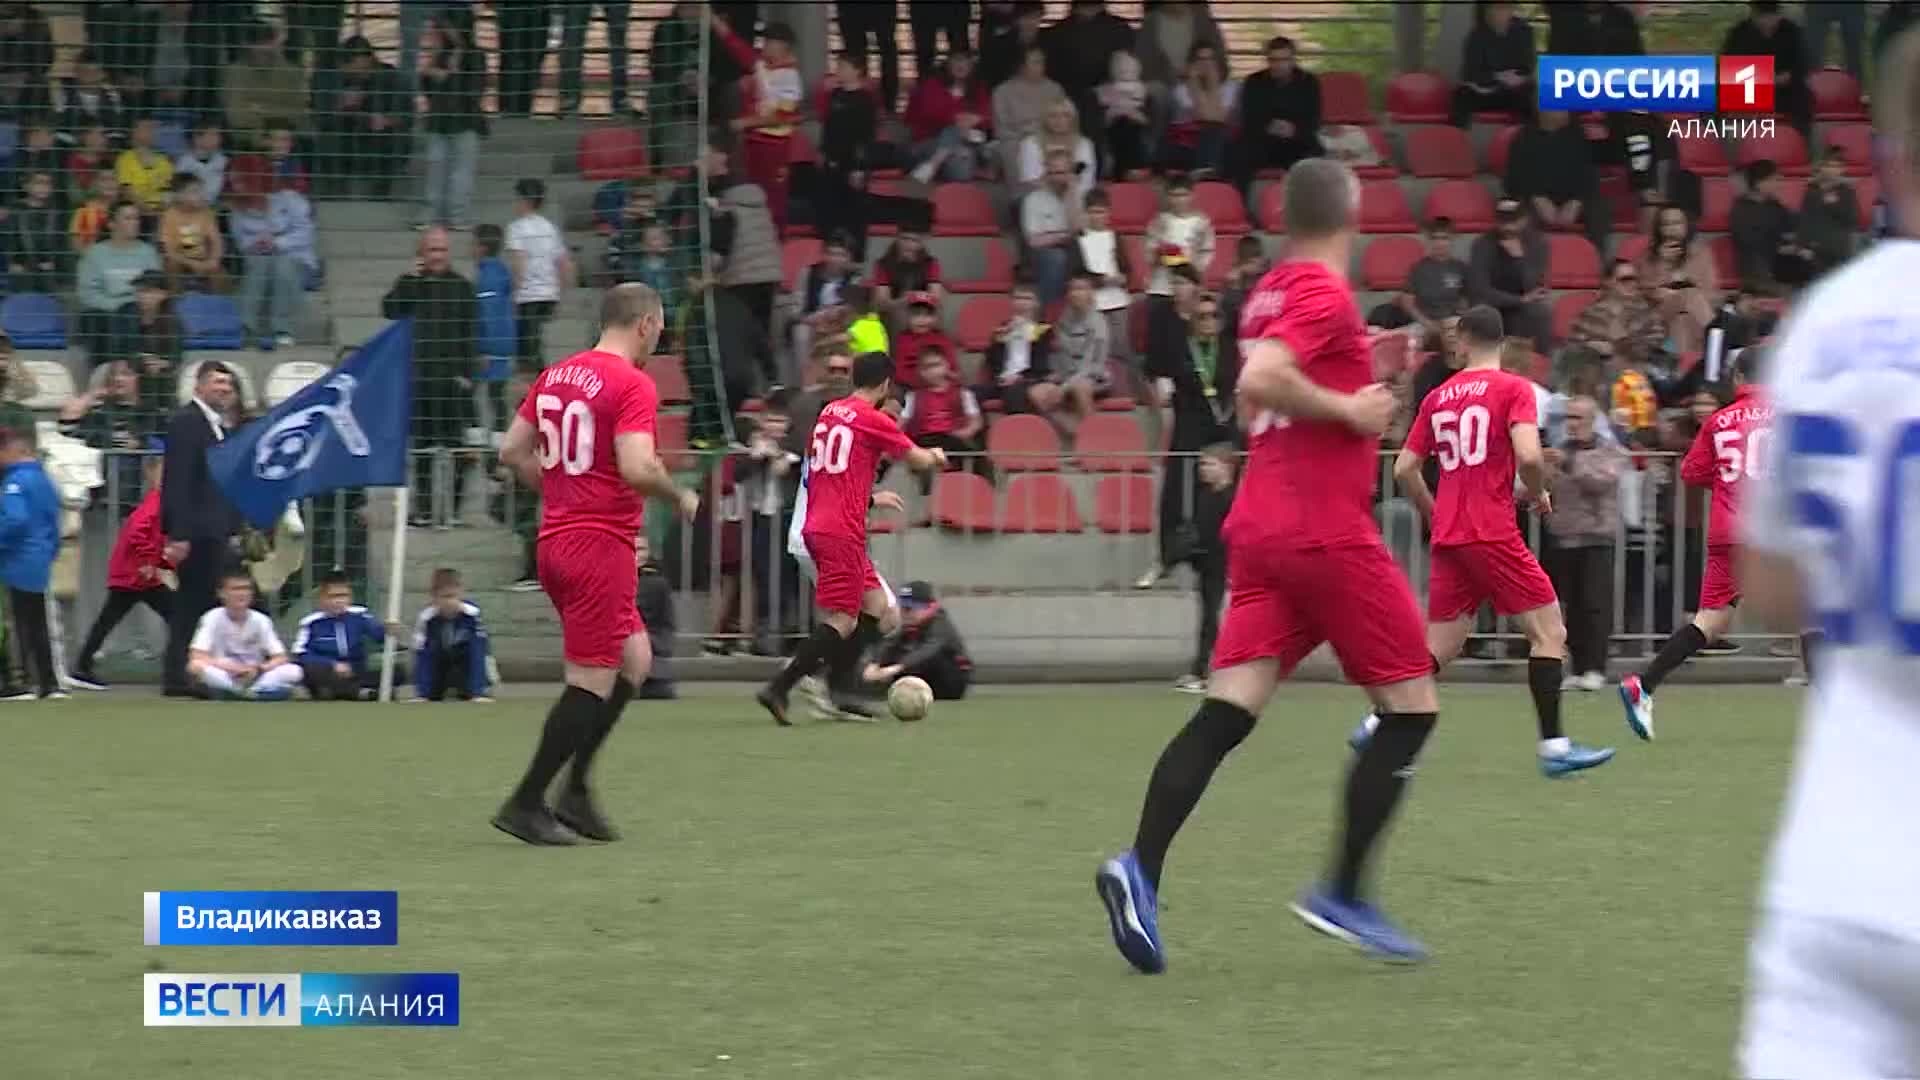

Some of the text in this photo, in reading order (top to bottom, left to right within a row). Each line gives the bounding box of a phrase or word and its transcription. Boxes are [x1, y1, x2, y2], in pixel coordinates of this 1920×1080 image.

[535, 393, 596, 476] 50
[809, 422, 854, 475] 50
[1431, 405, 1490, 472] 50
